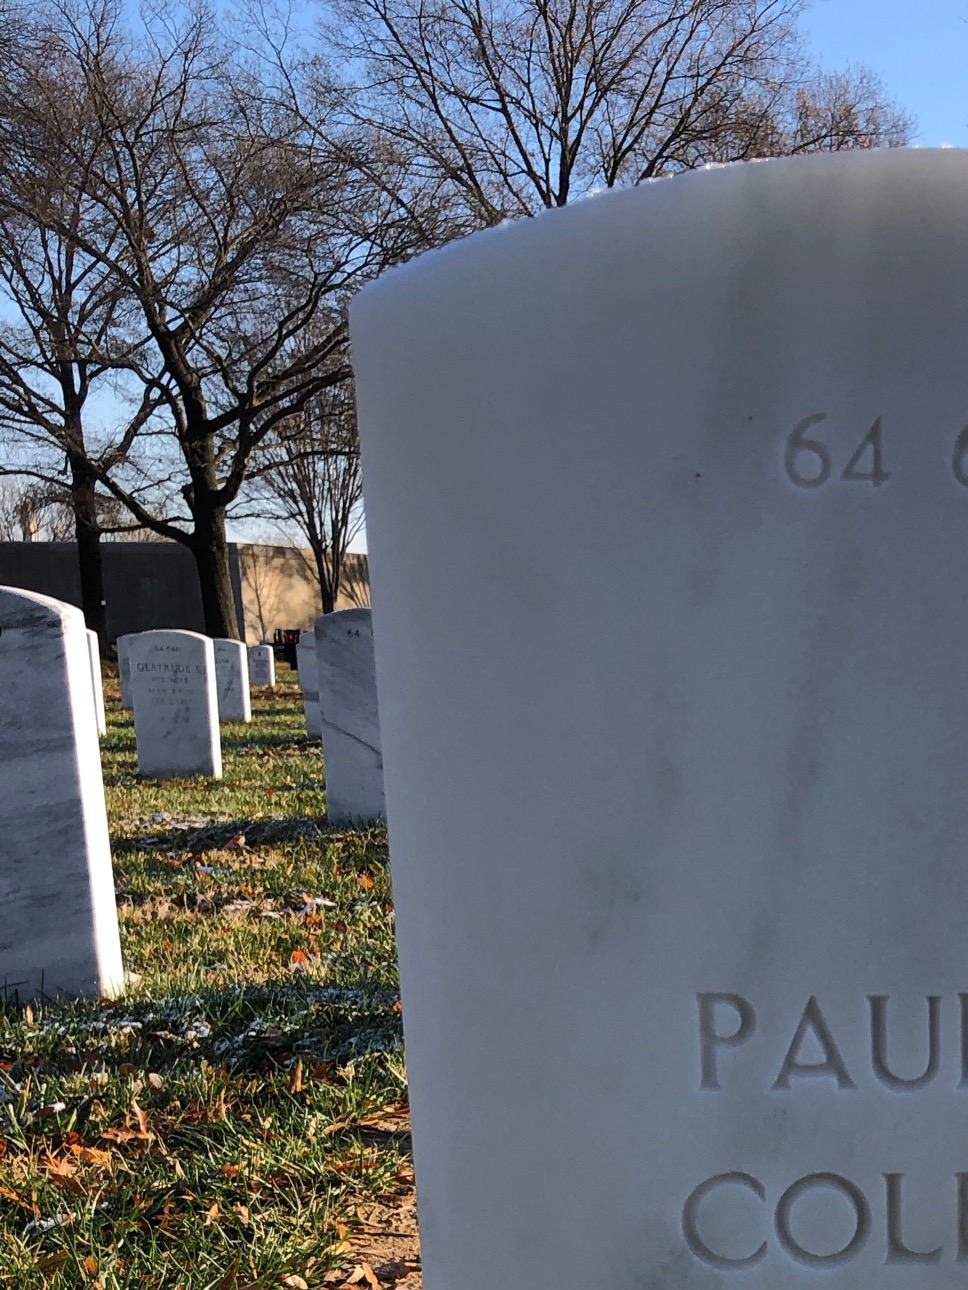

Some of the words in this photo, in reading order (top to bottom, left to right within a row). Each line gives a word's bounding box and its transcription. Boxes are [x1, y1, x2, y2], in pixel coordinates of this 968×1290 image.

[784, 412, 892, 490] 64
[347, 629, 360, 637] 64
[136, 662, 191, 673] GERTRUDE
